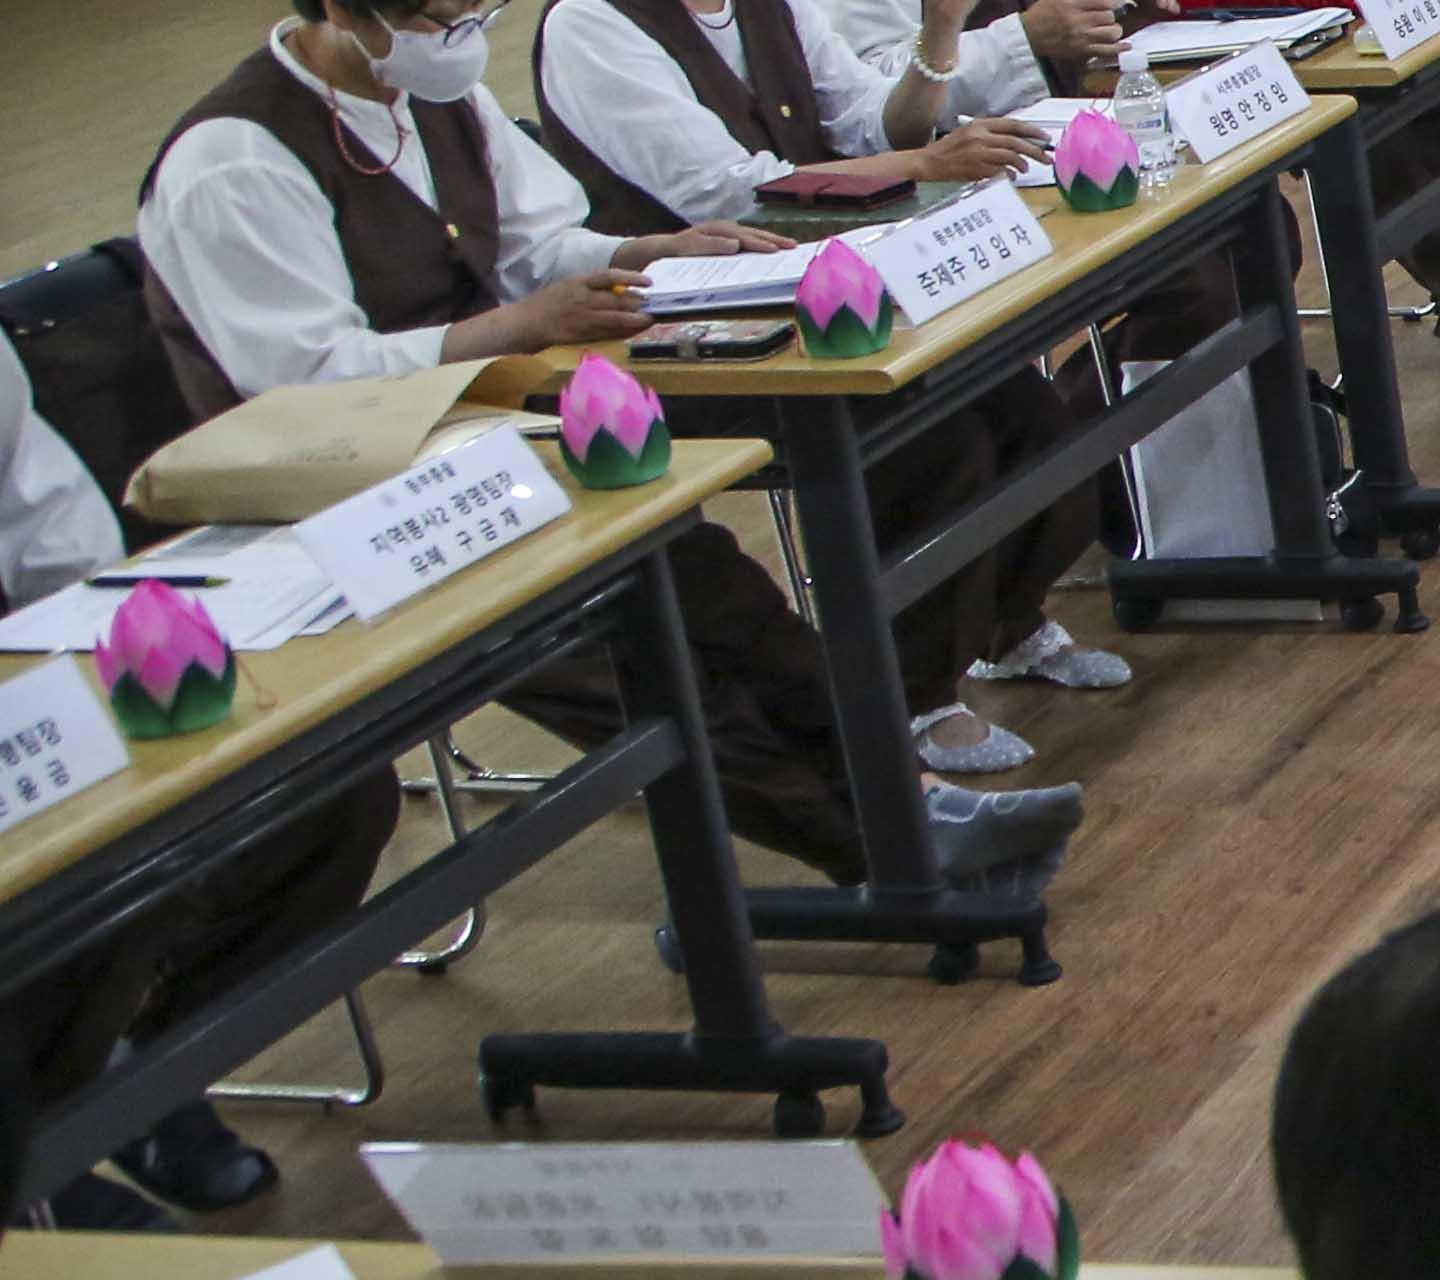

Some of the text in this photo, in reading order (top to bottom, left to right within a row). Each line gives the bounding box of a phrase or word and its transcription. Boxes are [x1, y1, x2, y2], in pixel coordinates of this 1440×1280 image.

[1217, 65, 1262, 93] 서부총괄팀장
[1238, 99, 1255, 121] 안
[1253, 90, 1272, 112] 정
[1270, 82, 1288, 104] 임
[932, 208, 992, 246] 동부총괄팀장
[917, 224, 1032, 296] 준제주 김 임 자
